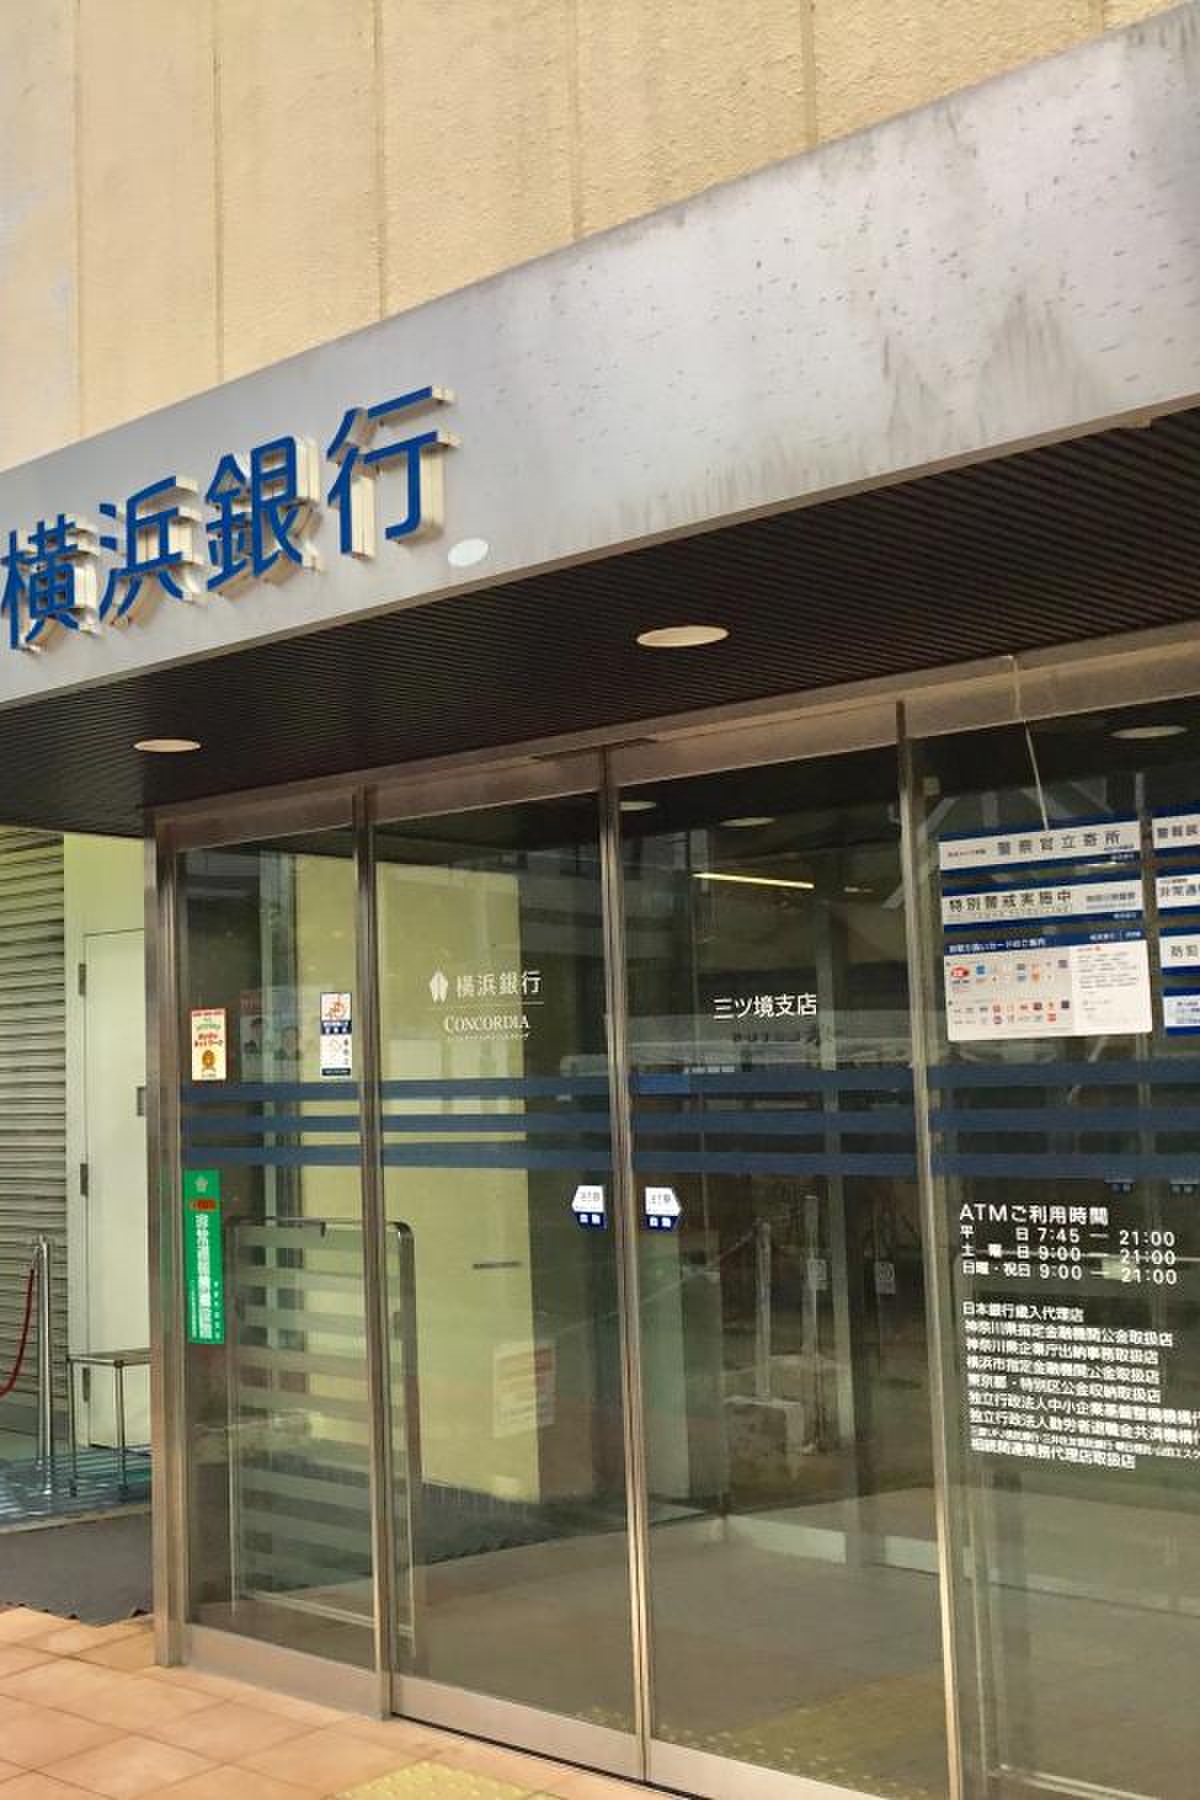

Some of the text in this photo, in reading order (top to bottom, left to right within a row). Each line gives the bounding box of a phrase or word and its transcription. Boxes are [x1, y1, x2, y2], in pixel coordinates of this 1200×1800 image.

[1, 385, 458, 654] 横浜銀行
[997, 830, 1121, 856] 警察官立寄所
[949, 889, 1072, 913] 特別警戒実施中
[1159, 882, 1200, 898] 非常通
[456, 970, 541, 999] 横浜銀行
[713, 993, 817, 1019] 三ツ境支店
[959, 1203, 1109, 1226] ATMご利用時間
[1037, 1227, 1080, 1244] 7:45
[1119, 1231, 1176, 1247] 21:00
[1039, 1246, 1081, 1261] 9:00
[1119, 1249, 1176, 1266] 21:00
[962, 1261, 1031, 1278] 日曜・祝日
[1040, 1264, 1082, 1280] 9:00
[1121, 1268, 1178, 1285] 21:00
[962, 1300, 1084, 1323] 日本銀行歳入代理店
